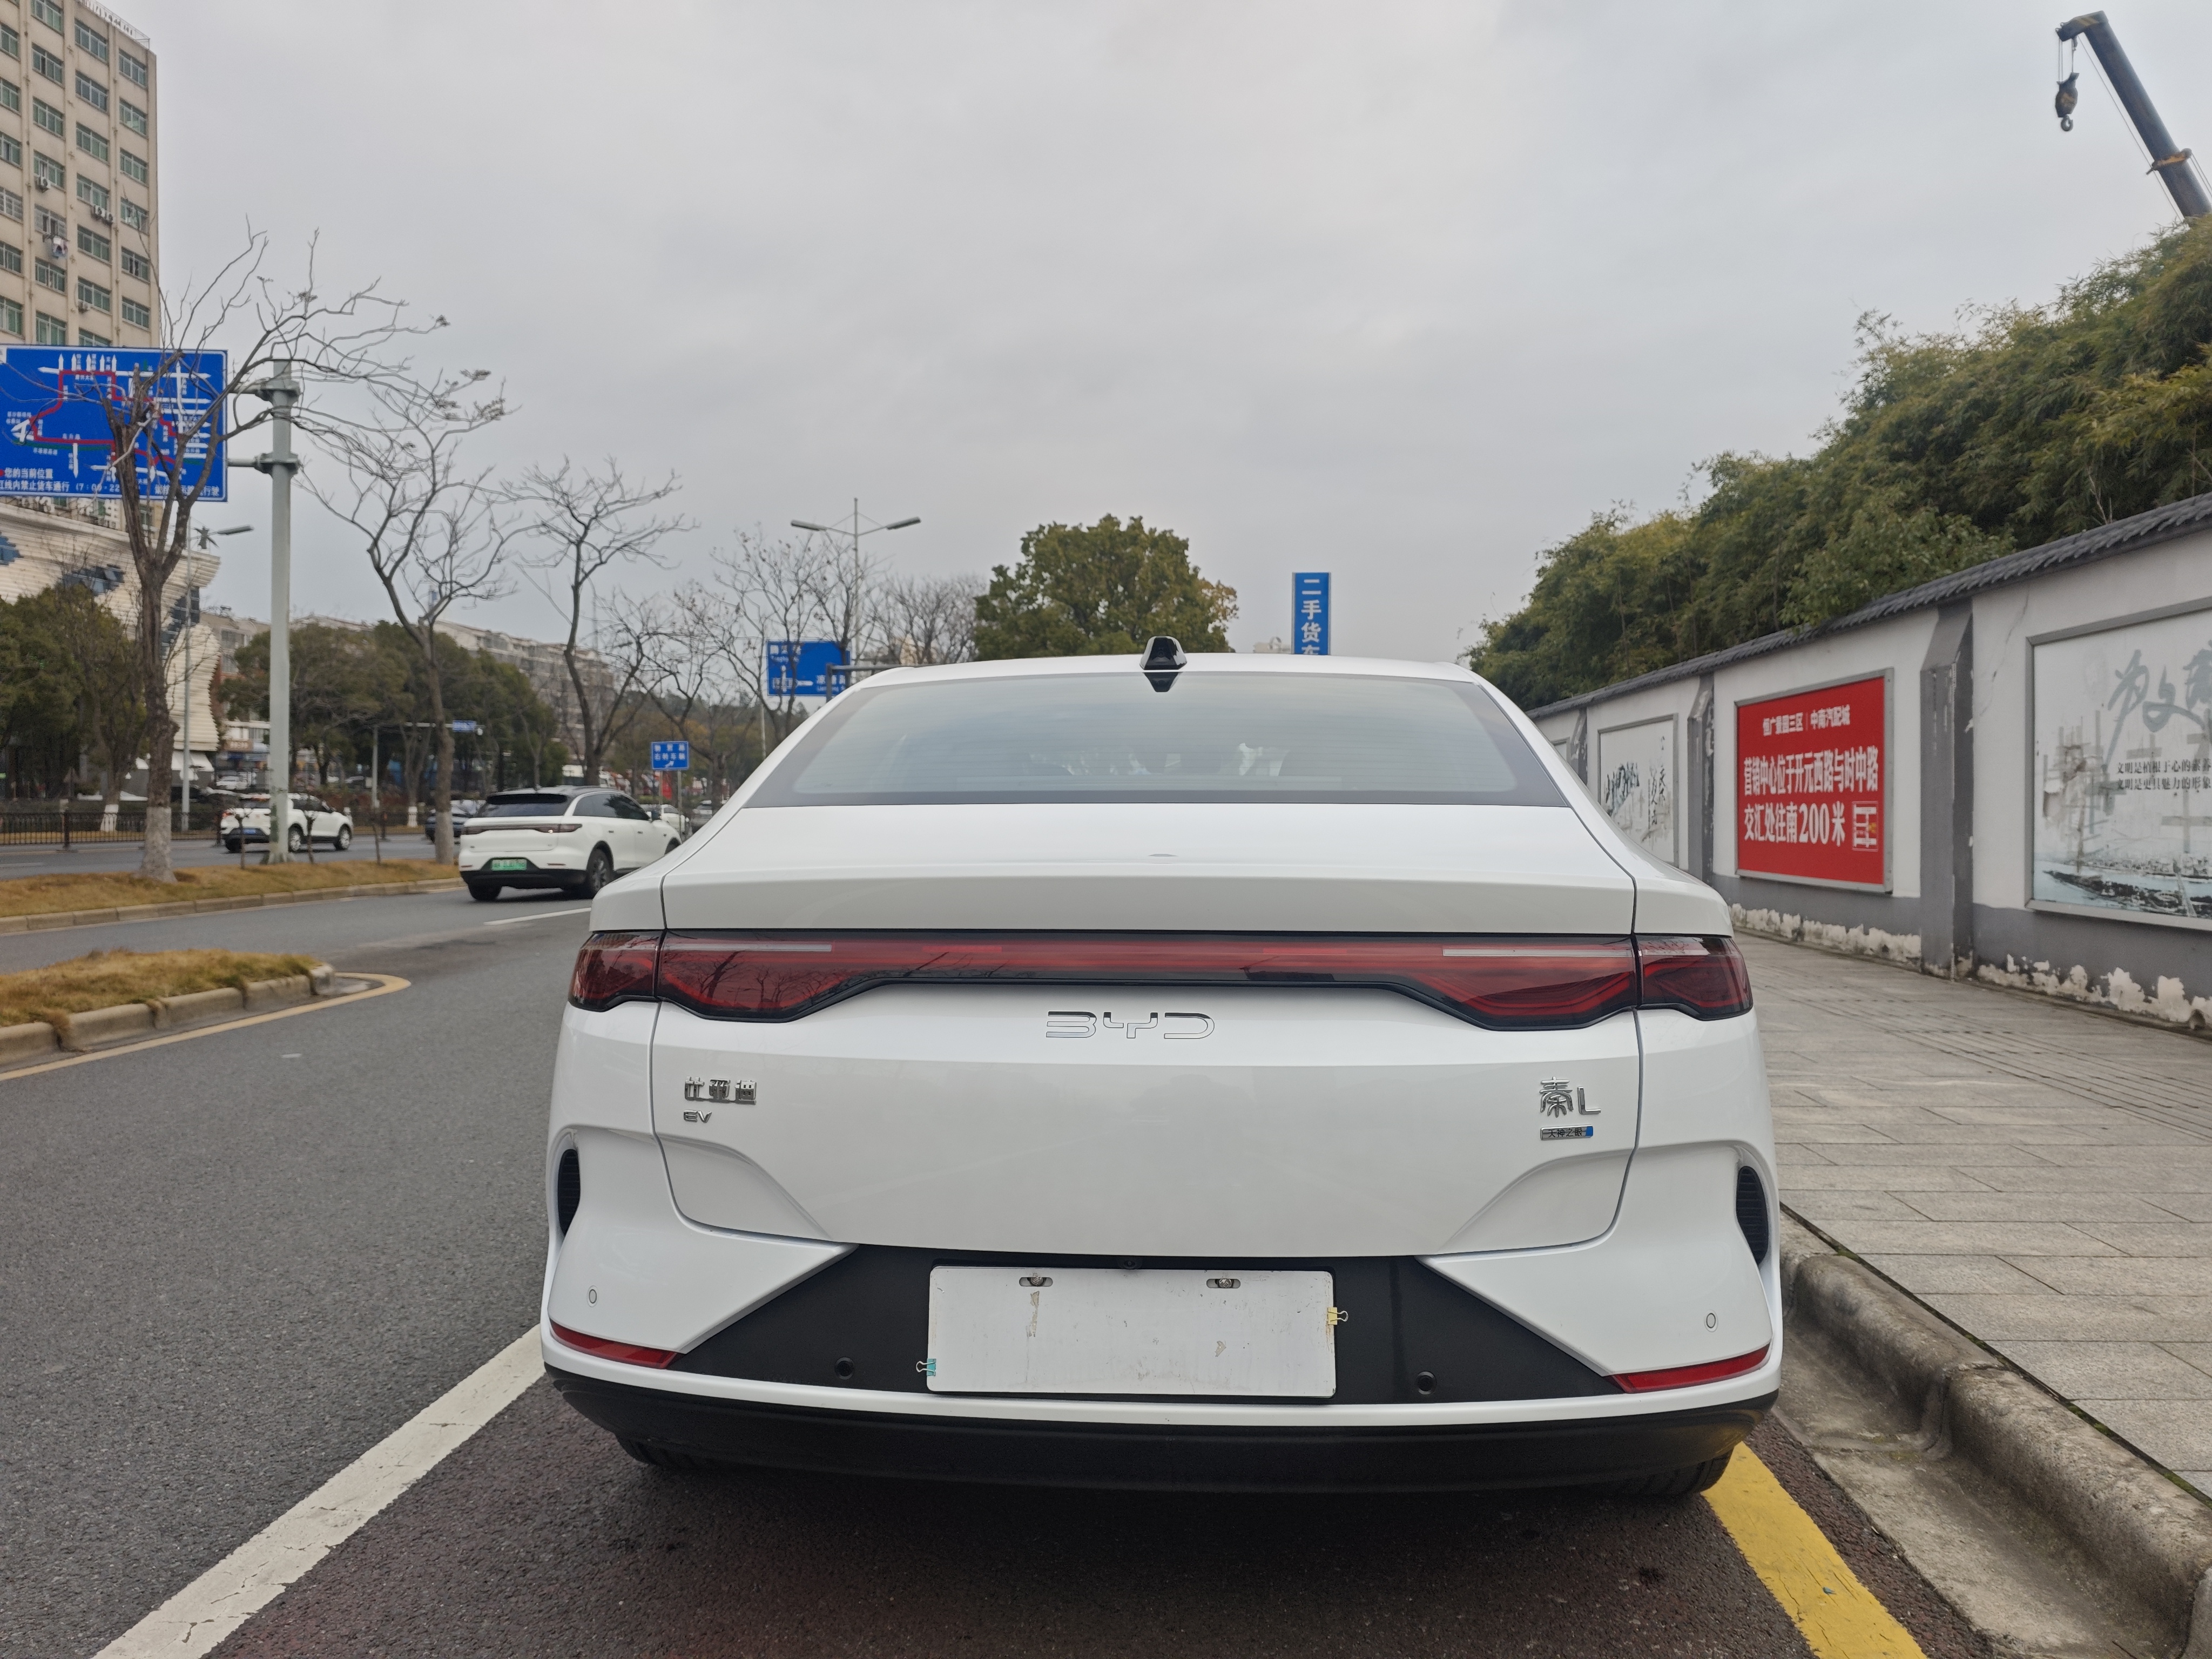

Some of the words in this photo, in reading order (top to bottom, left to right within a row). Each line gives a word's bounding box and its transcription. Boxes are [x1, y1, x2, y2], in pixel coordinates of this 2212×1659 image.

[4, 467, 53, 480] 您的当前位置
[1744, 745, 1879, 797] 营销中心位于开元西路与时中路
[1744, 801, 1845, 847] 交汇处往南200米
[1046, 1006, 1215, 1039] BYD
[684, 1076, 757, 1105] 比亚迪
[684, 1109, 712, 1123] EV
[1548, 1128, 1583, 1138] 天神之眼
